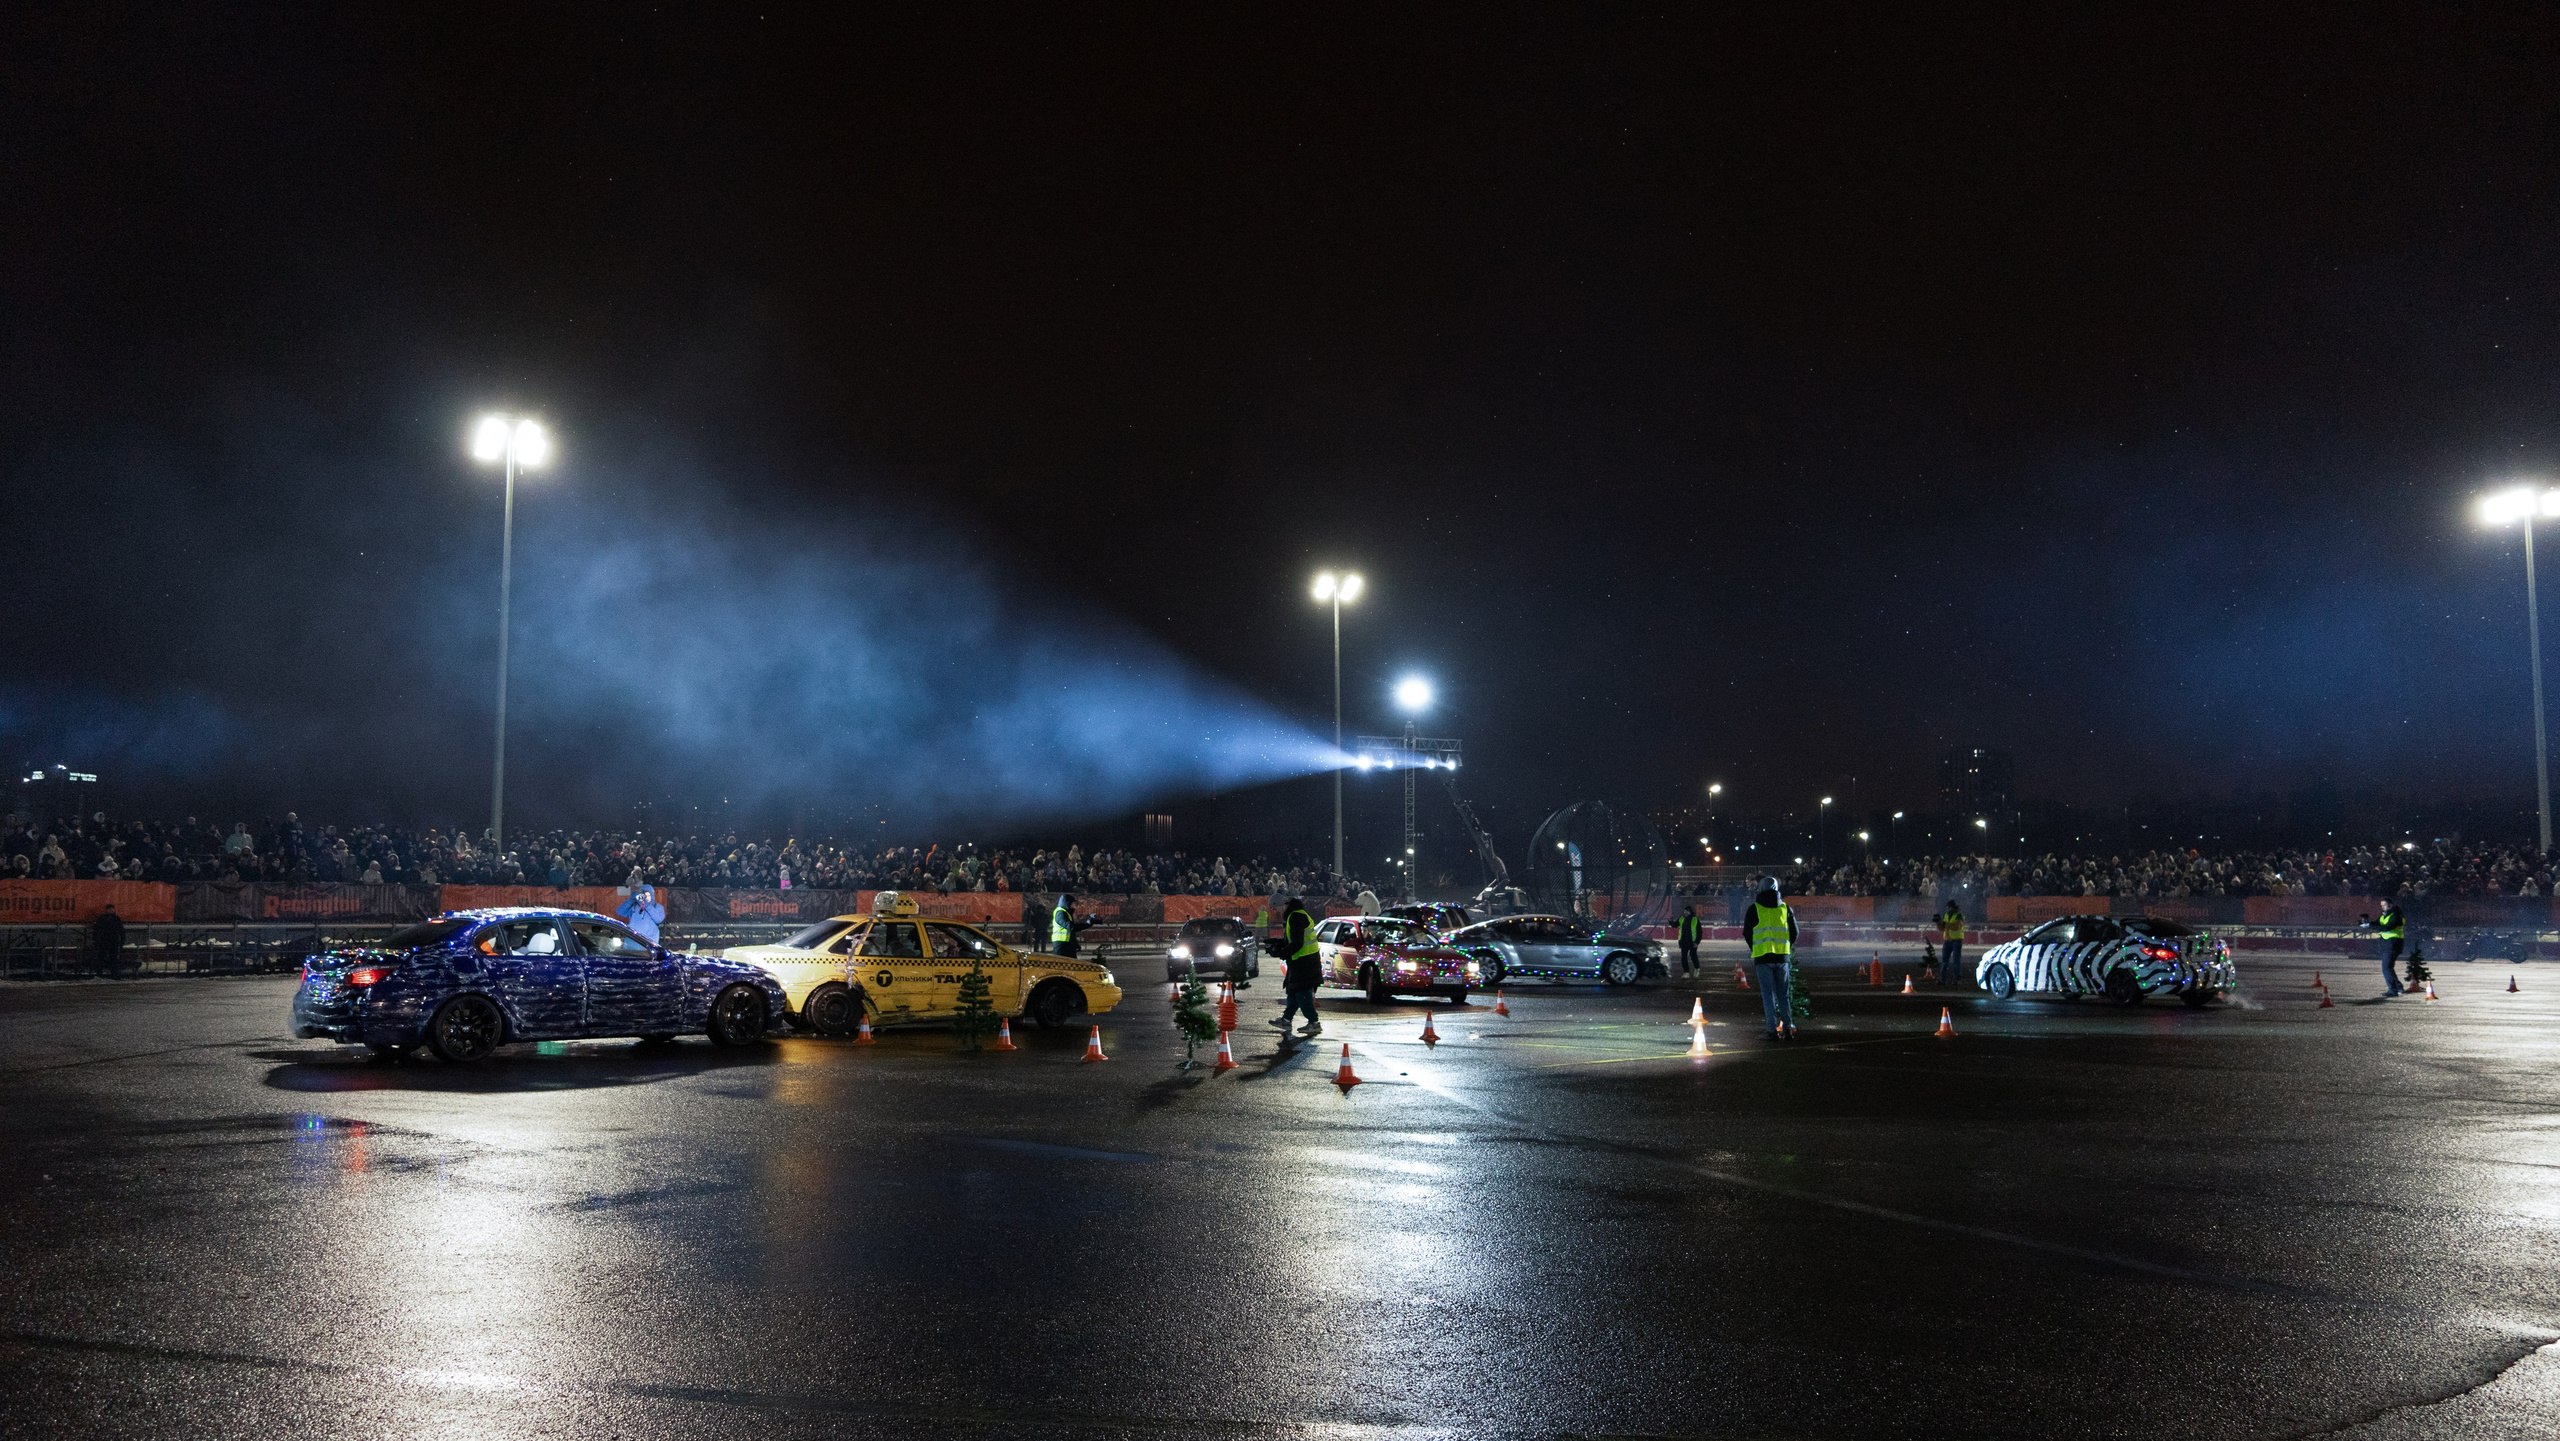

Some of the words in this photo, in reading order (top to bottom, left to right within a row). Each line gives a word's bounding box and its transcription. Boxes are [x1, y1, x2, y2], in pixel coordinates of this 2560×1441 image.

[264, 895, 360, 918] Remington
[730, 899, 799, 919] Remington
[934, 974, 993, 984] ТАКИ
